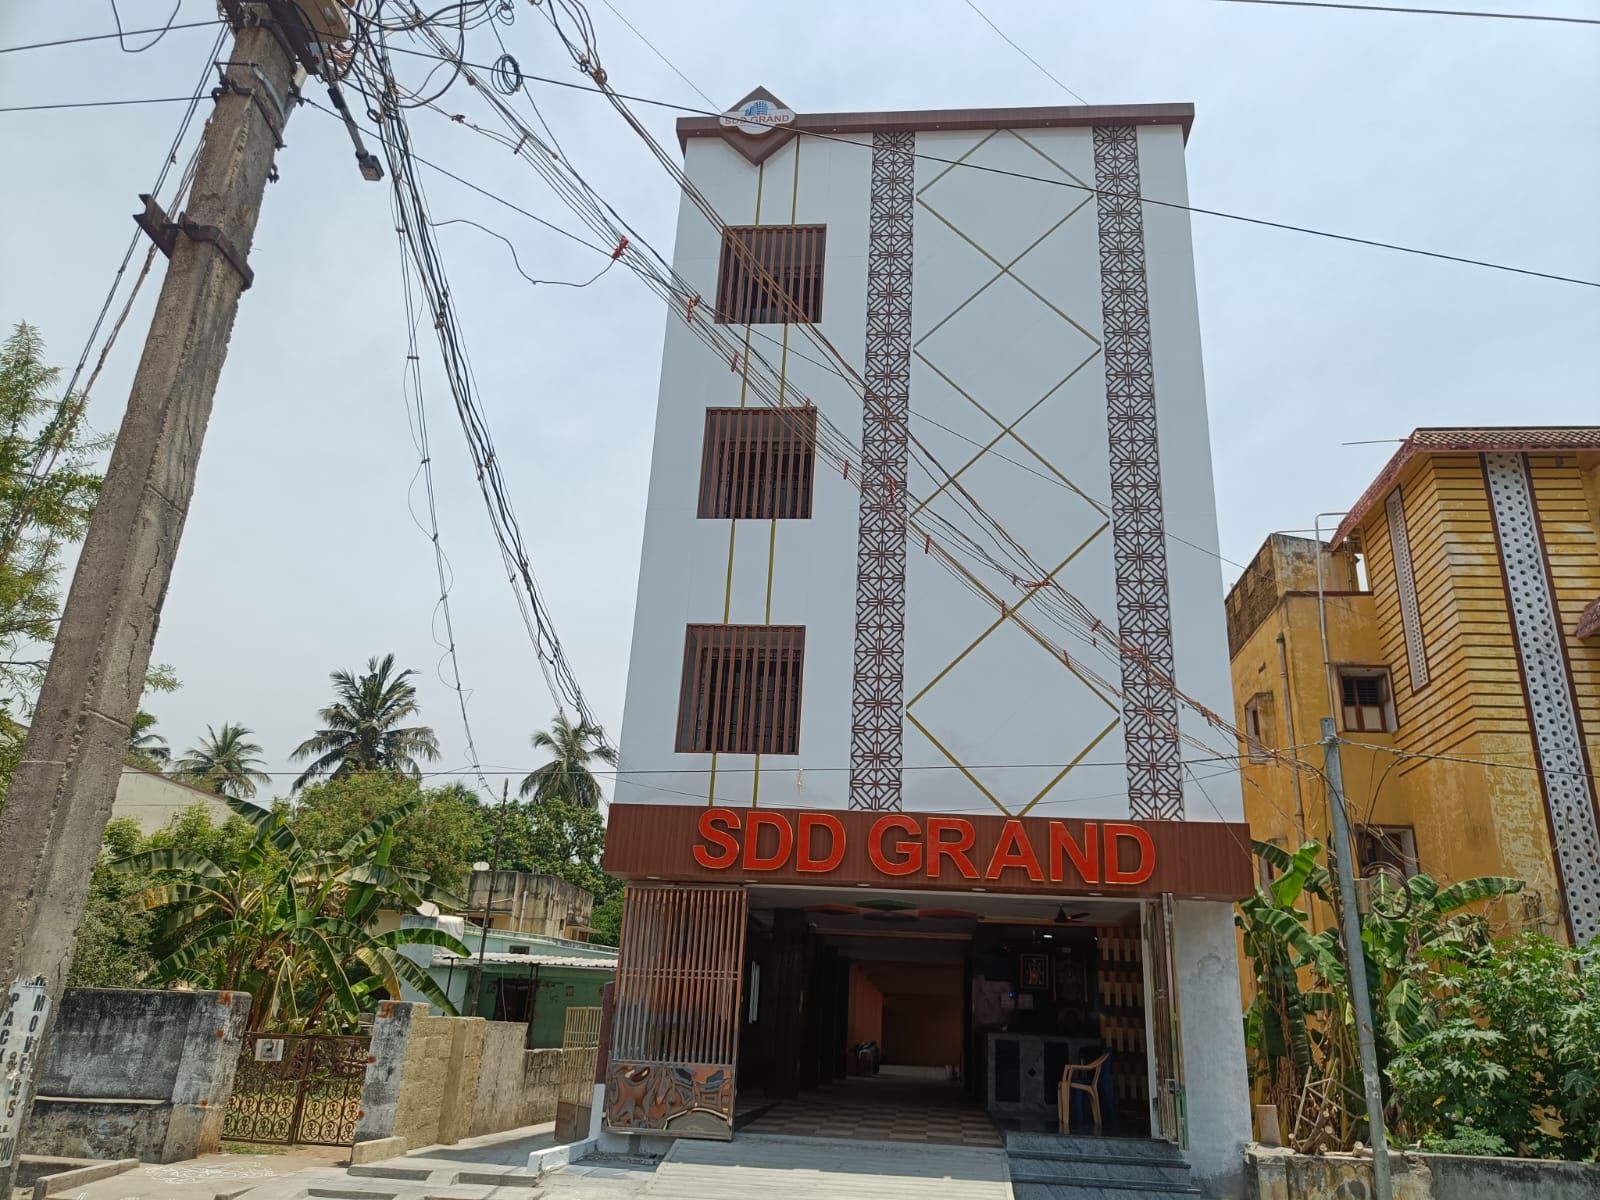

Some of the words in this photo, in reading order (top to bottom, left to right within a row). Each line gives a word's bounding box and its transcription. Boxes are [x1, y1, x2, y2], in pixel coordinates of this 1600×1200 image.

[751, 115, 789, 123] GRAND
[692, 808, 846, 872] SDD
[868, 815, 1156, 884] GRAND
